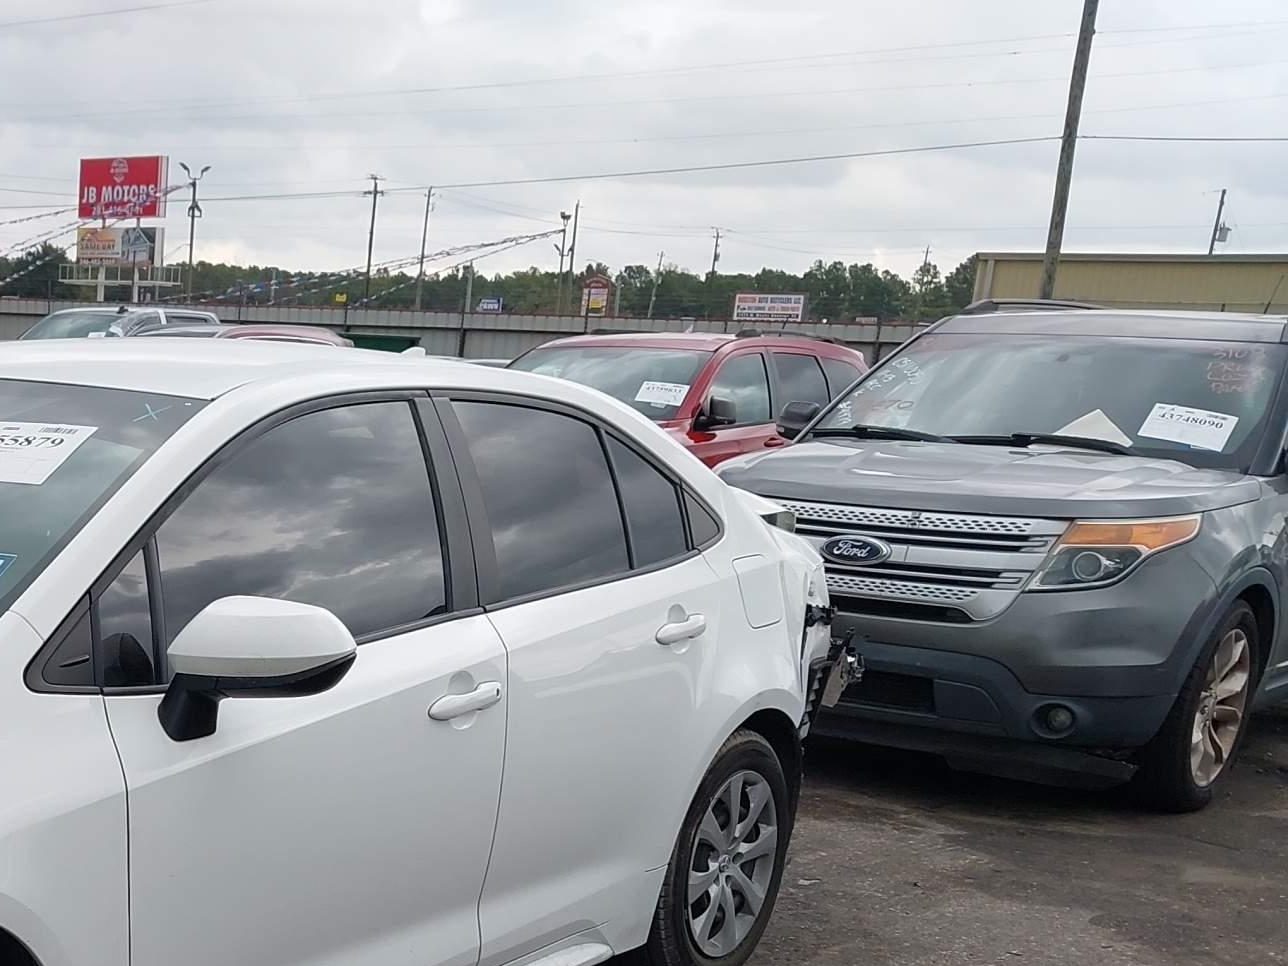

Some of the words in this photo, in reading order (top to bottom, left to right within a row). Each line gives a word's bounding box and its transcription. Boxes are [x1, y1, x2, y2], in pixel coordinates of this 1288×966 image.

[82, 186, 96, 203] JB
[101, 185, 155, 203] MOTORS
[1158, 411, 1224, 429] 43748090
[833, 539, 871, 557] Ford
